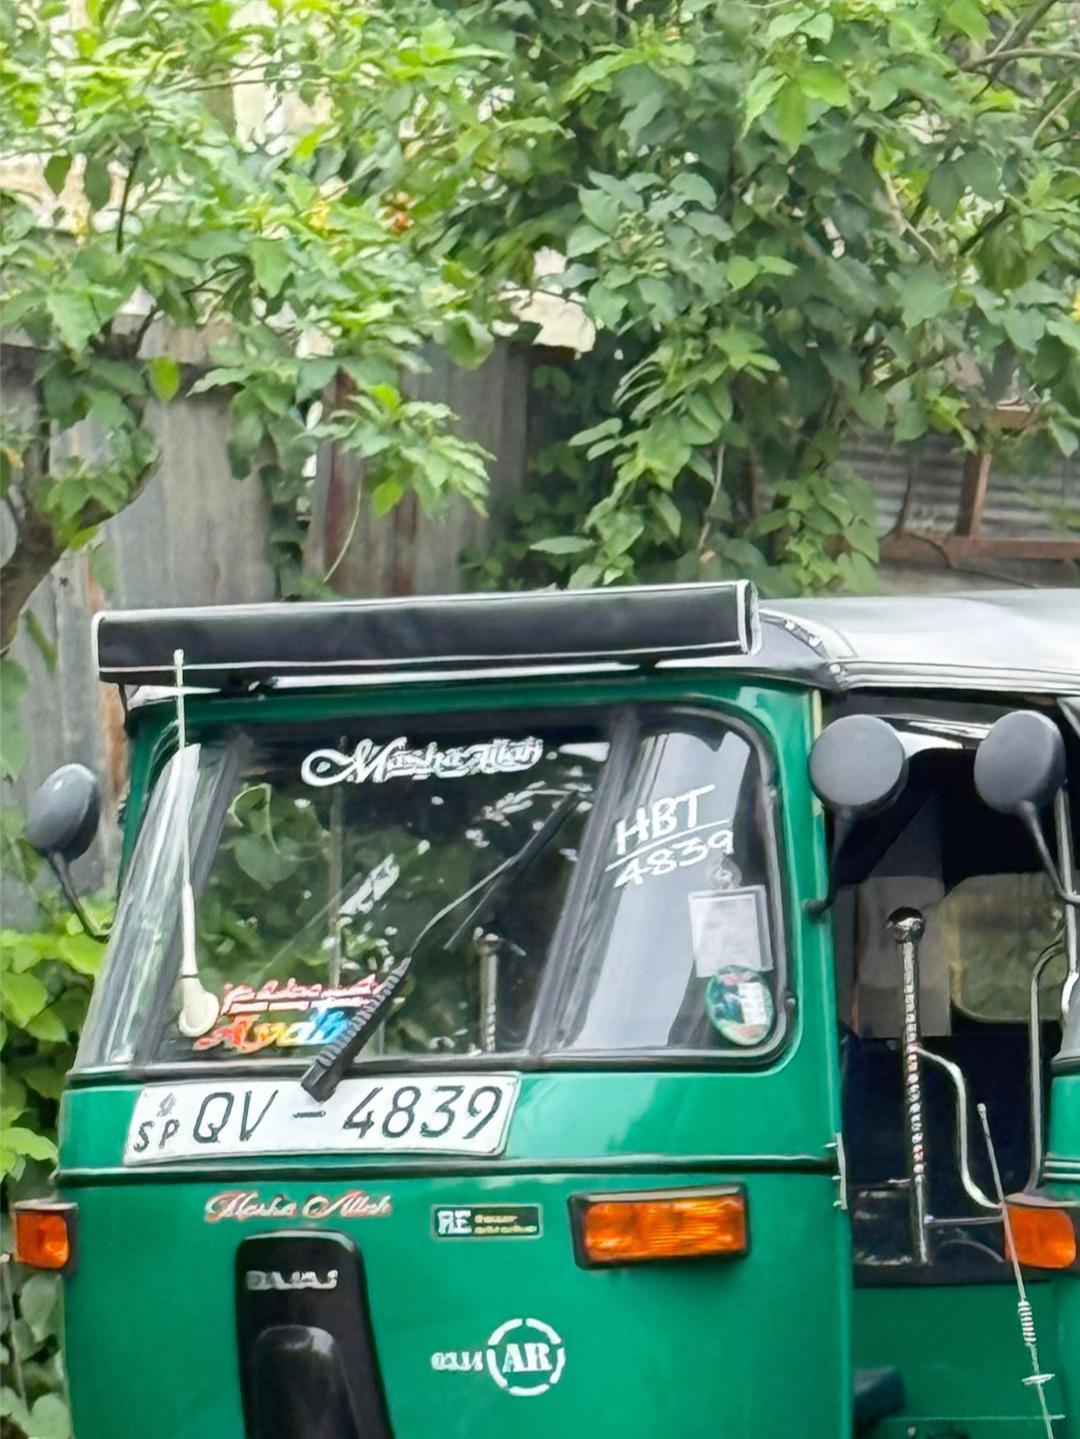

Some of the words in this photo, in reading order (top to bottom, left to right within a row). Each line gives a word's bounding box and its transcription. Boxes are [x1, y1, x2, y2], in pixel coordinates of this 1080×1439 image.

[614, 783, 716, 856] HBT
[614, 829, 734, 889] 4839
[132, 1118, 182, 1153] SP
[193, 1089, 280, 1144] QV
[342, 1084, 504, 1141] 4839
[502, 1342, 553, 1374] AR
